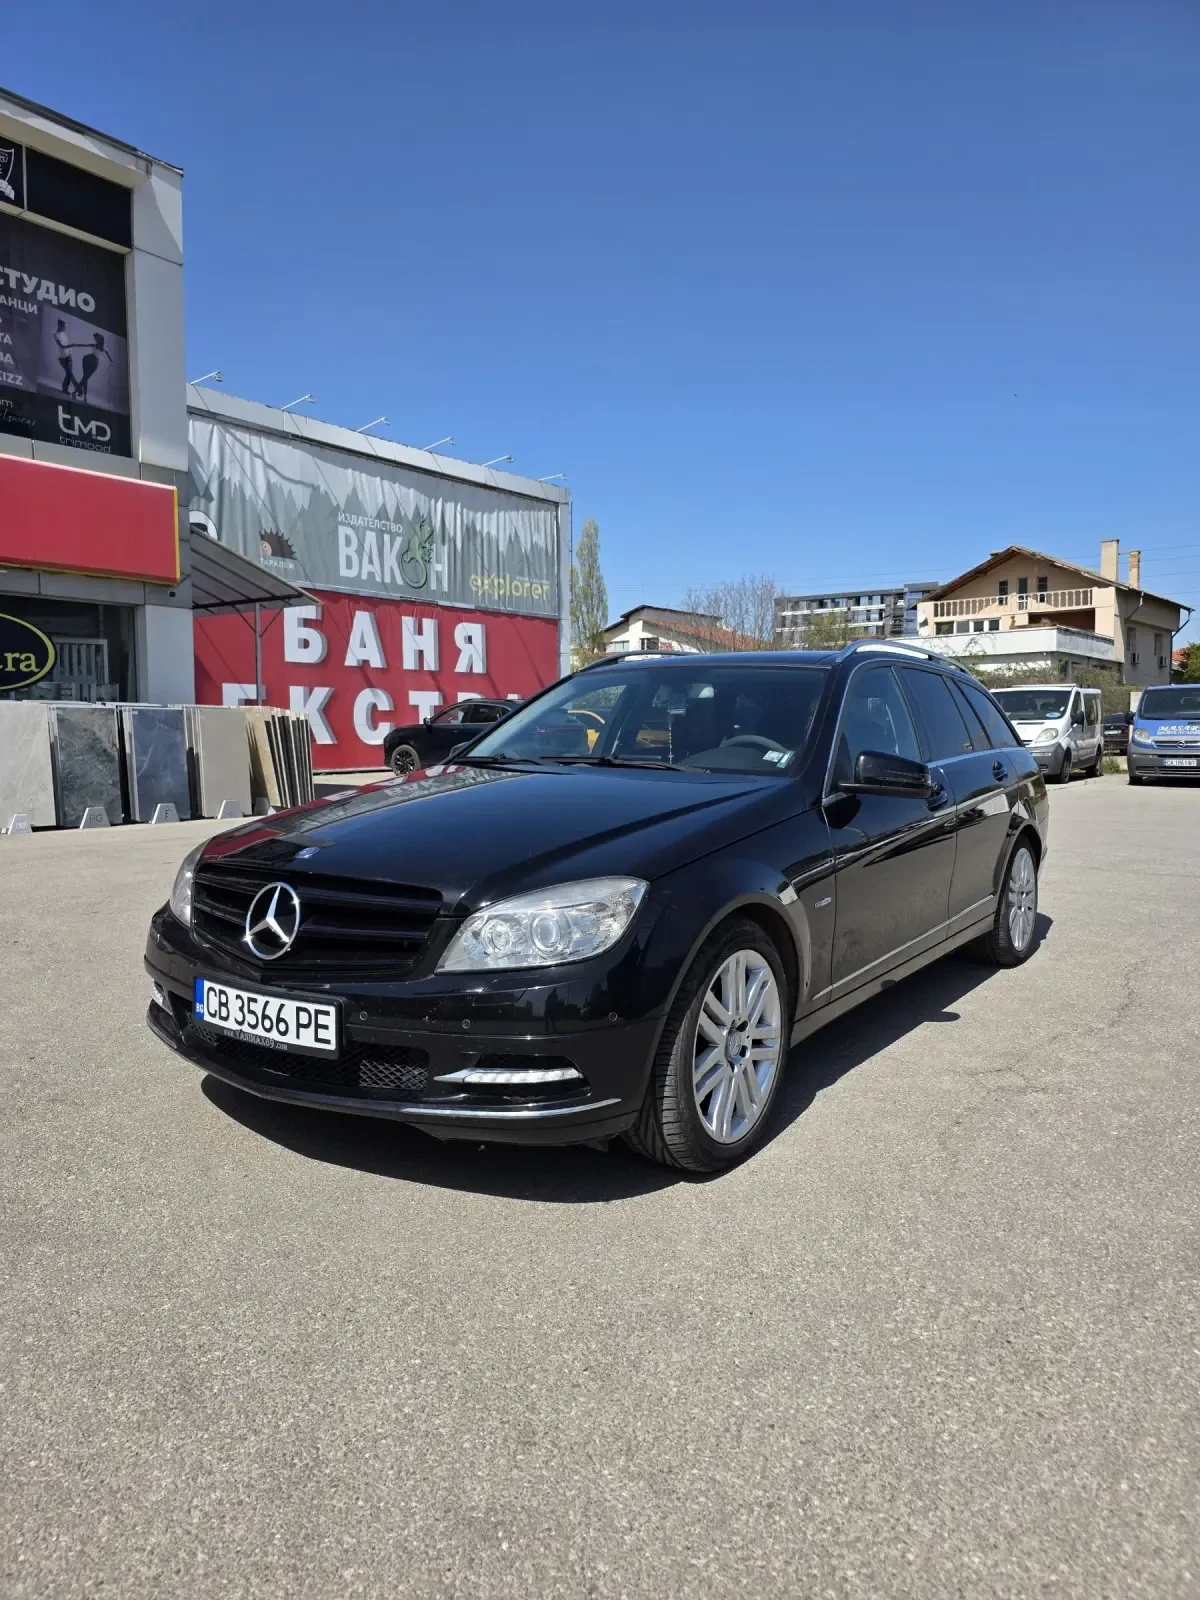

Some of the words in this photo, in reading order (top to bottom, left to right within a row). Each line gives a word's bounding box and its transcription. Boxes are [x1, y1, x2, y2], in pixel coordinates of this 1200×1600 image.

[60, 435, 111, 453] trimood
[338, 511, 403, 533] ИЗДАТЕЛСТВО
[469, 572, 551, 600] explorer
[283, 604, 487, 674] БАНЯ
[0, 652, 40, 672] ra
[222, 682, 528, 746] КСТ
[195, 1002, 204, 1014] BG
[206, 986, 230, 1022] CB
[234, 994, 290, 1037] 3566
[295, 1005, 332, 1045] PE
